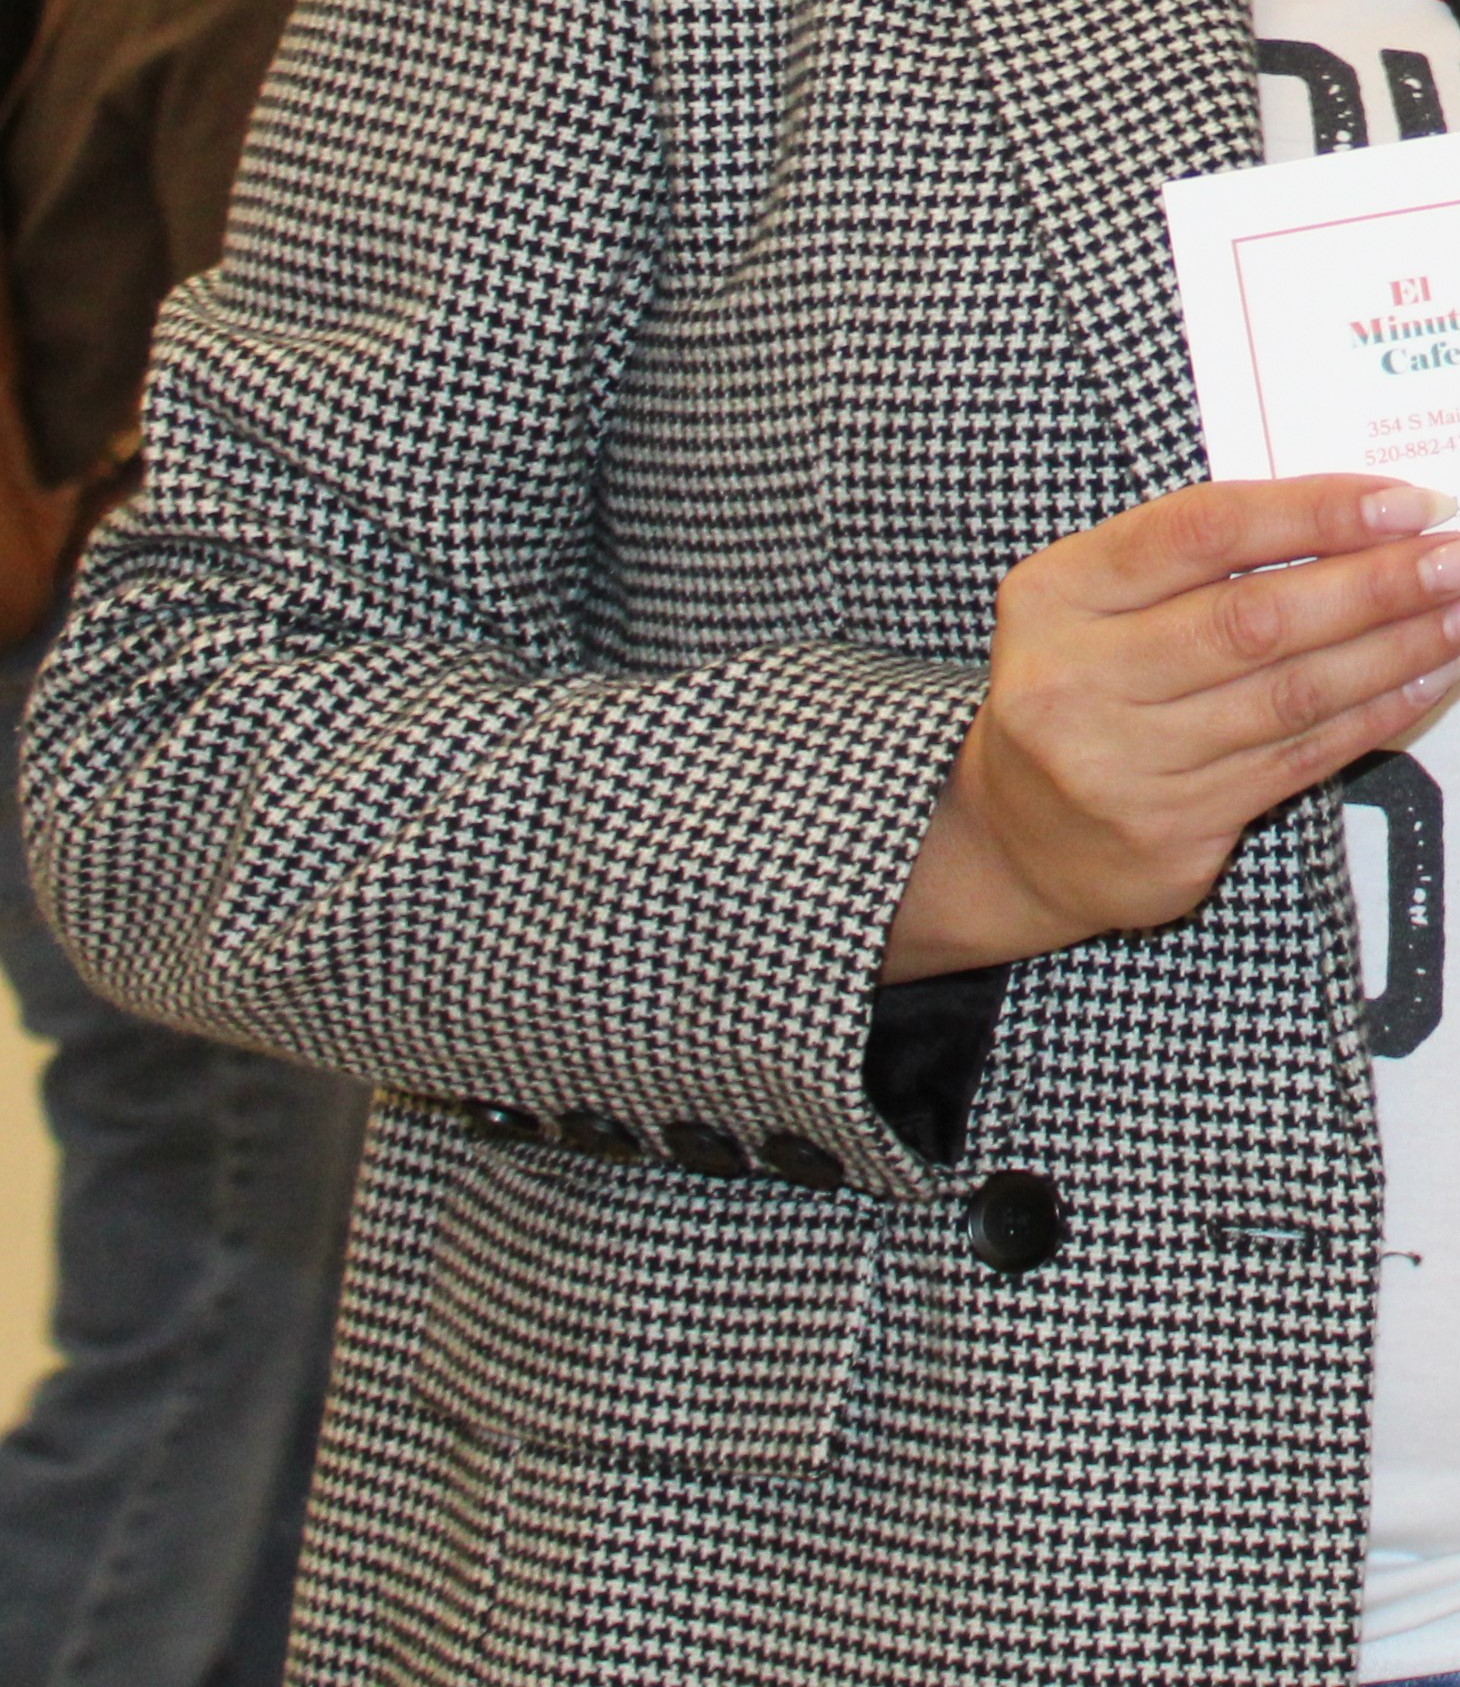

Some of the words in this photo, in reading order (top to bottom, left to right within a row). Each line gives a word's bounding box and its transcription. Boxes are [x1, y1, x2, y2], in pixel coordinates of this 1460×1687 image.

[1389, 275, 1432, 307] El
[1367, 417, 1403, 439] 354
[1408, 412, 1422, 431] S
